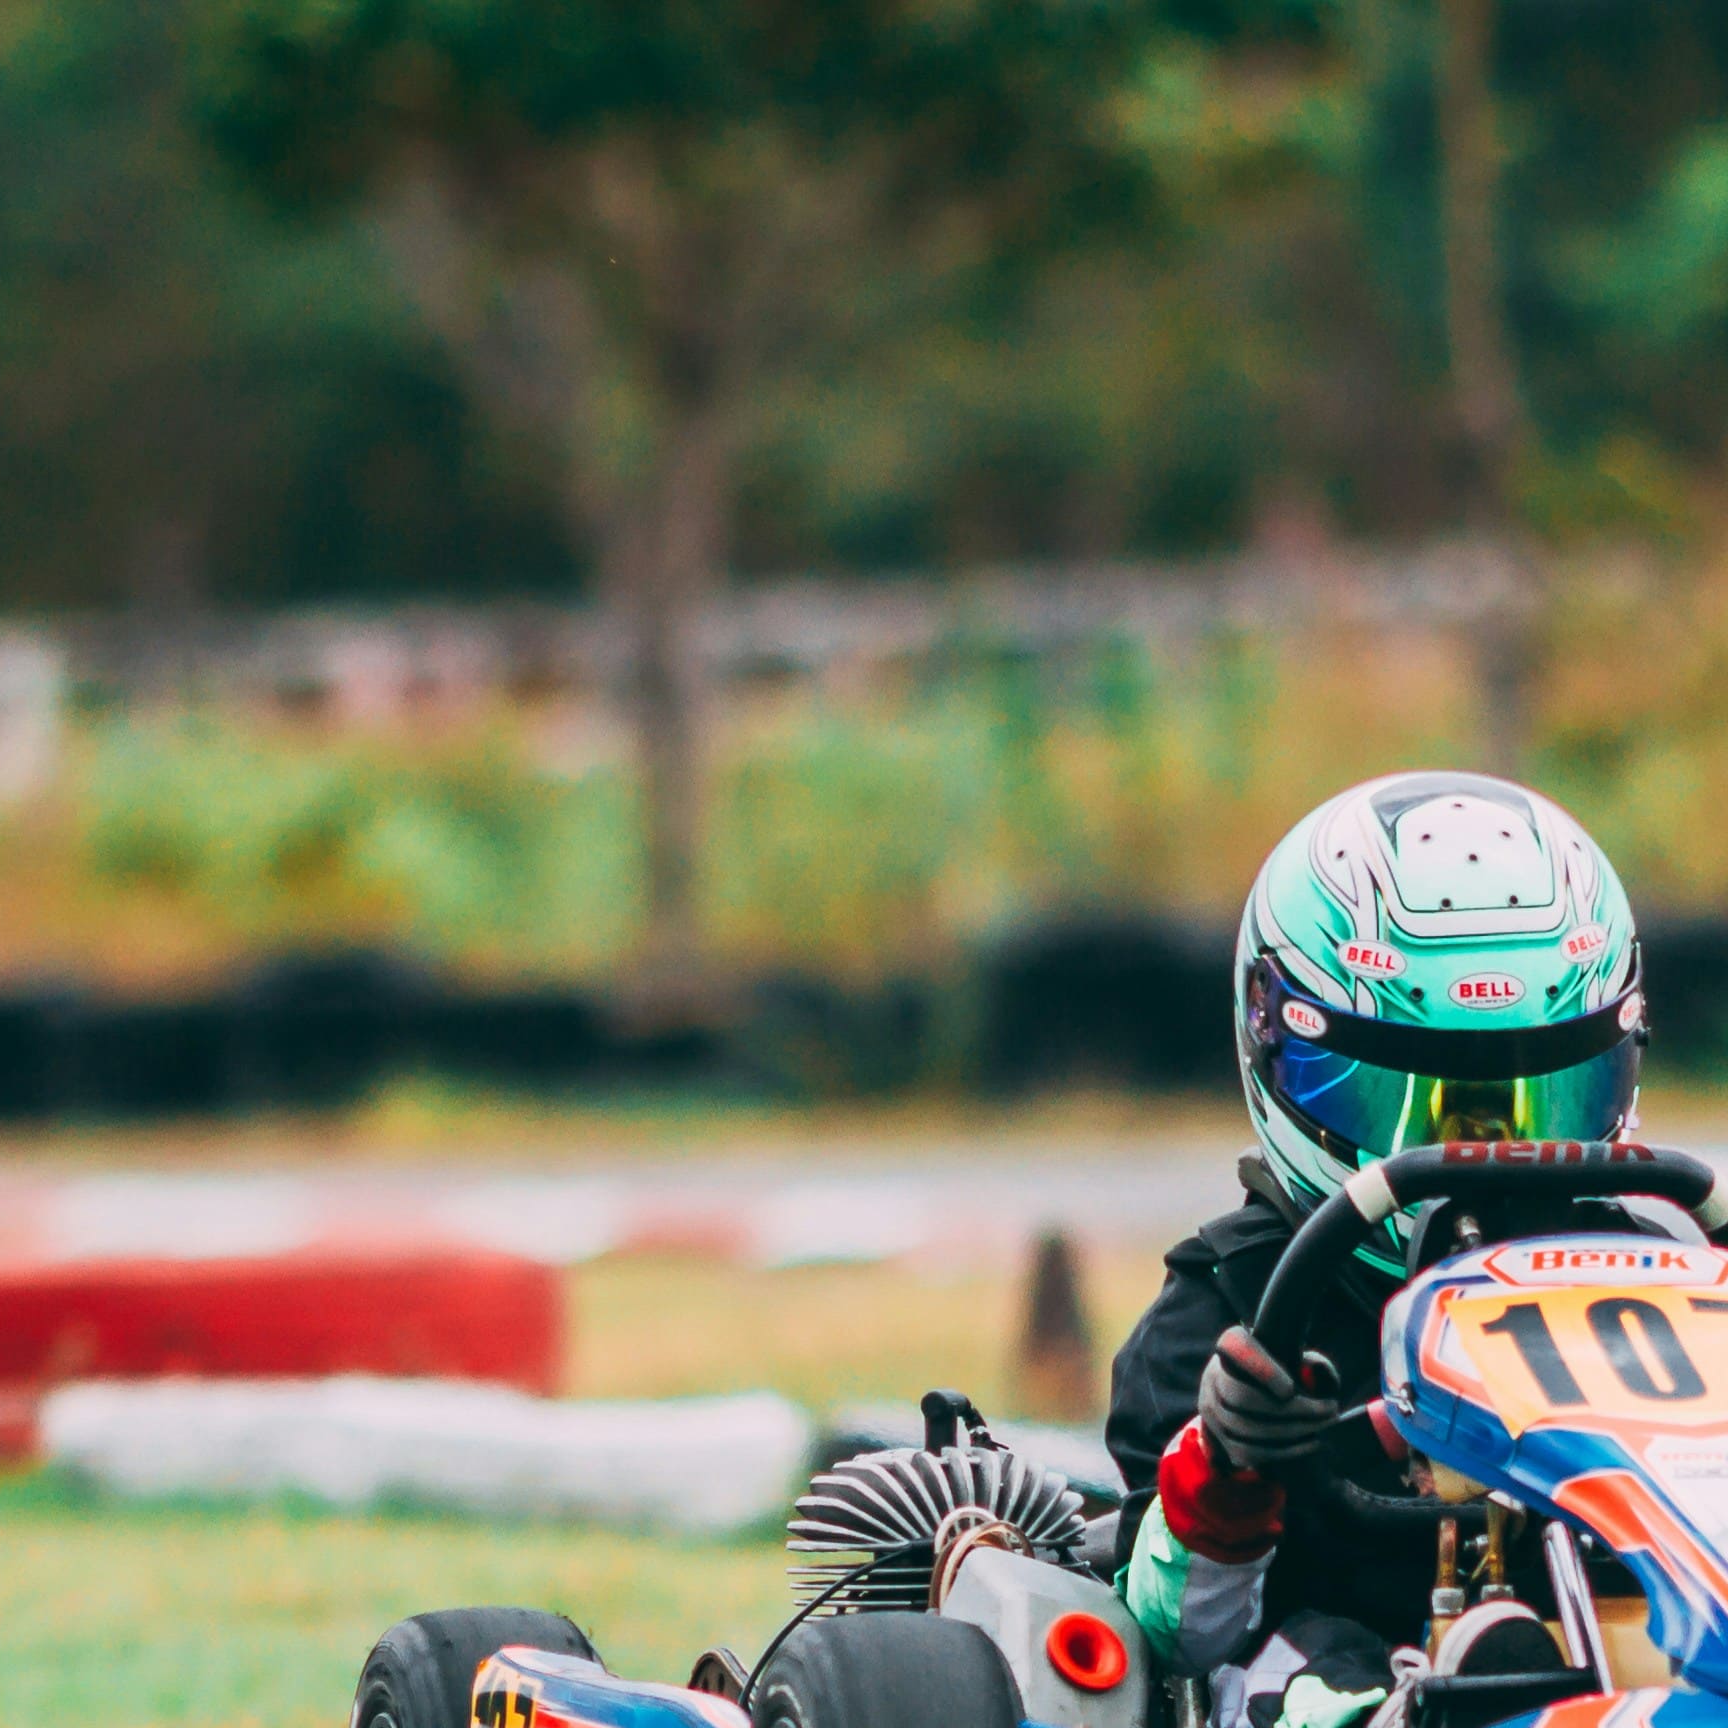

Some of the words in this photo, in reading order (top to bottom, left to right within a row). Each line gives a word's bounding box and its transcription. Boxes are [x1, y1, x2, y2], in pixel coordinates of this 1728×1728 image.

[1568, 931, 1602, 955] BELL
[1347, 946, 1396, 971] BELL
[1459, 981, 1515, 998] BELL
[1289, 1006, 1319, 1030] BELL
